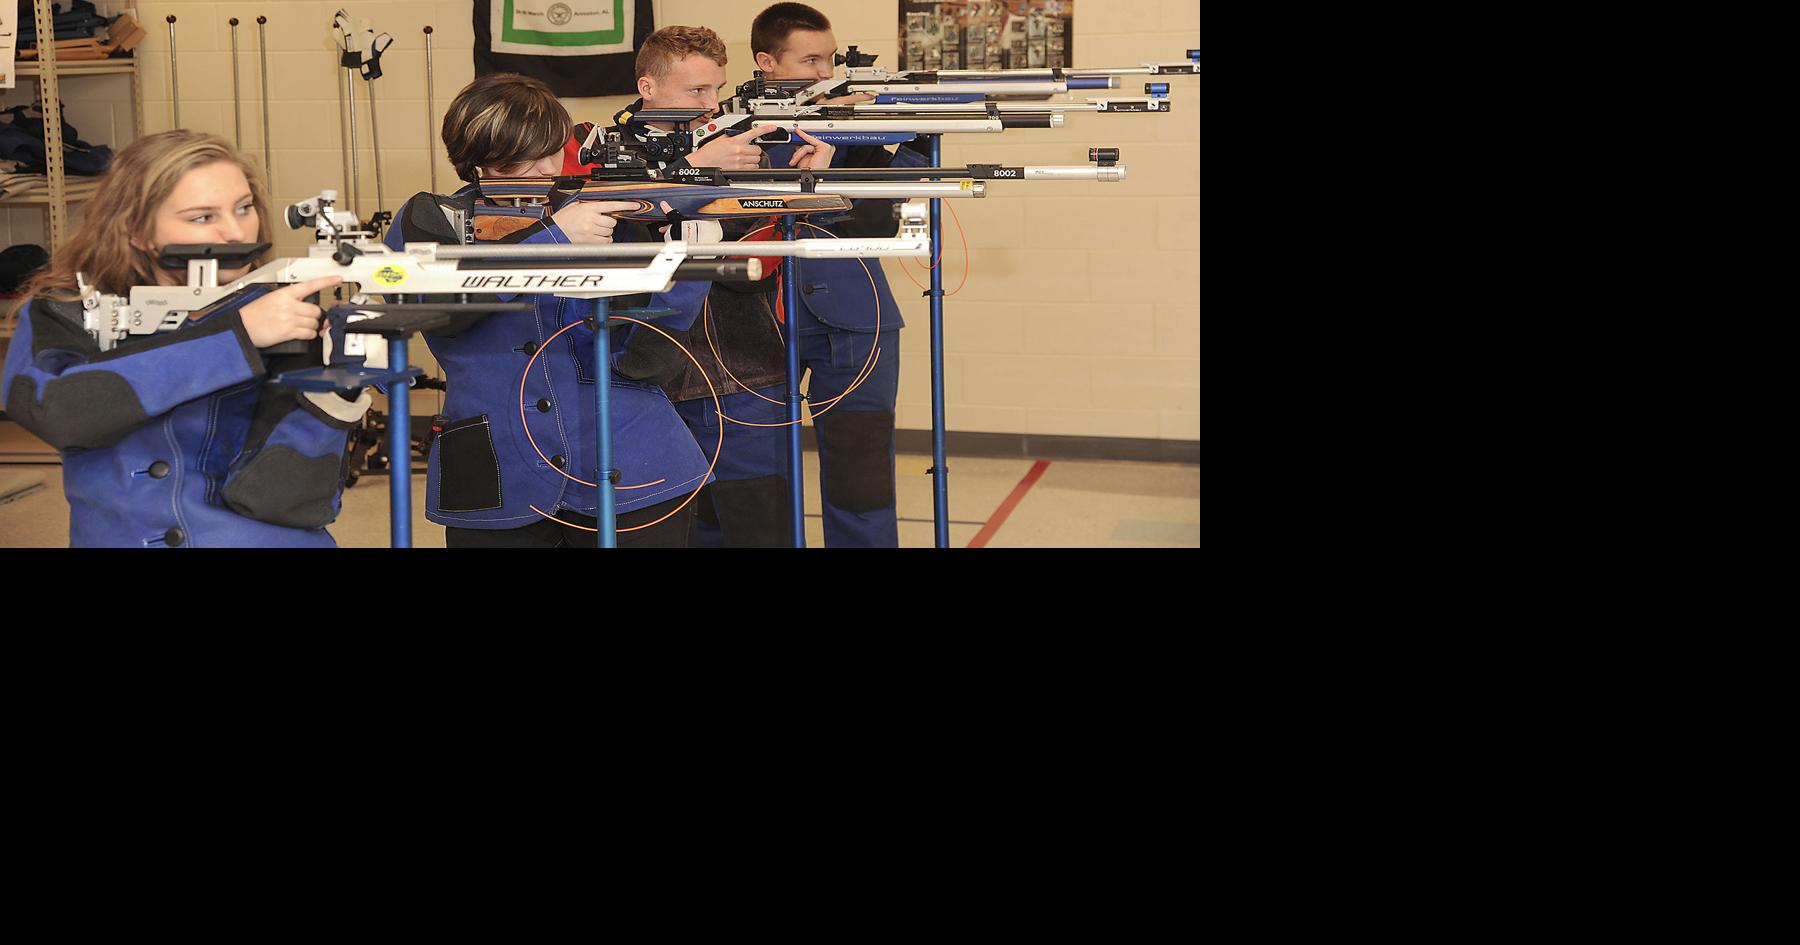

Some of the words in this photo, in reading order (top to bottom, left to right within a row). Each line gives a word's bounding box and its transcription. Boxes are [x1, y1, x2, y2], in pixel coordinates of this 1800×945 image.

[678, 168, 700, 176] 8002
[993, 169, 1016, 177] 8002
[742, 200, 784, 208] ANSCHUTZ
[461, 275, 604, 288] WALTHER
